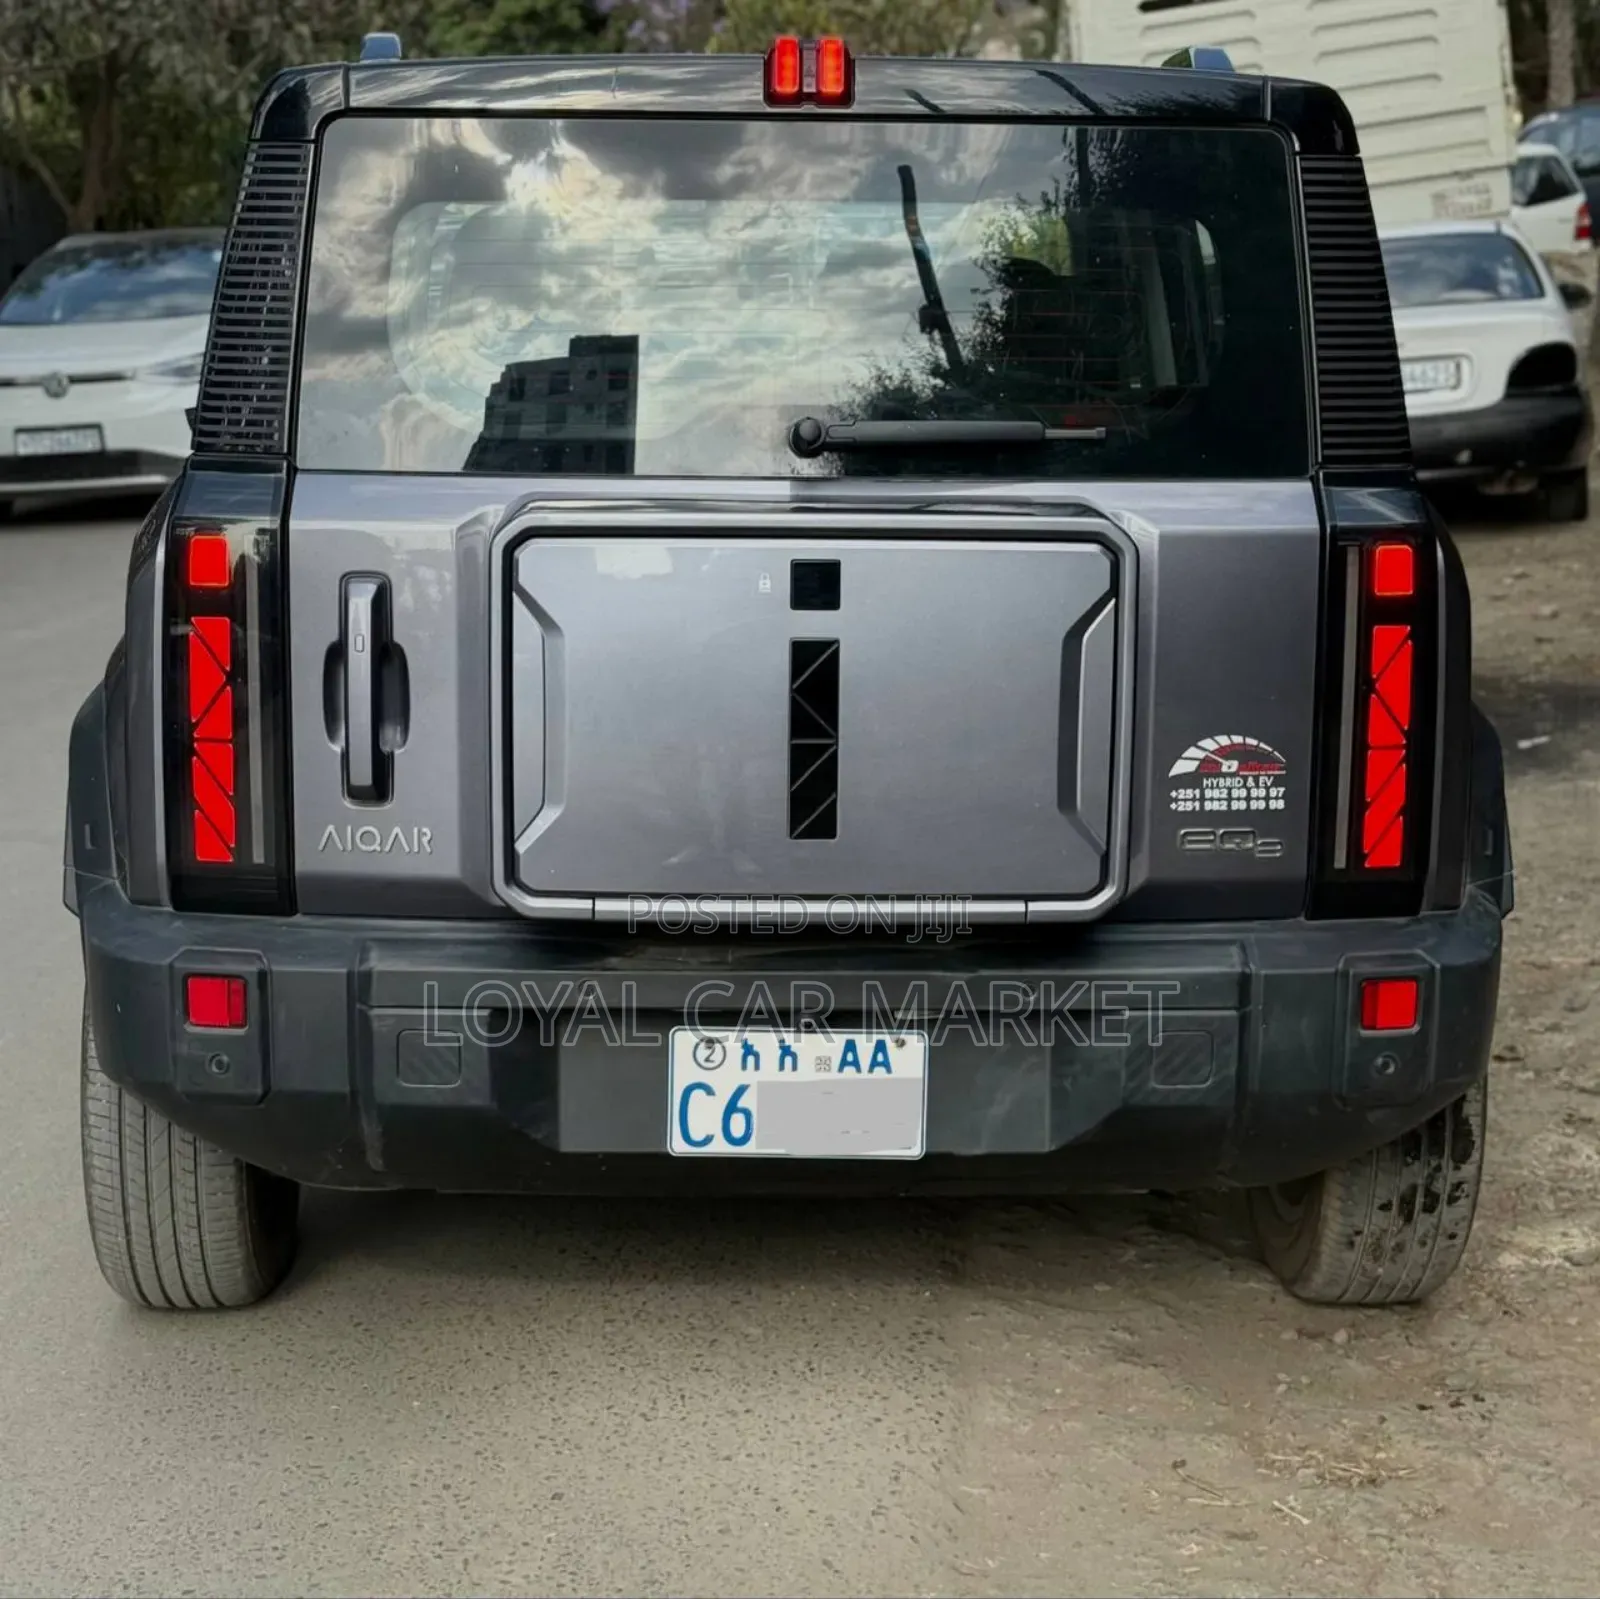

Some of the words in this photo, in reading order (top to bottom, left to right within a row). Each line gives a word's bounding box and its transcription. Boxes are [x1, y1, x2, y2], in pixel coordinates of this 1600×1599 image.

[1203, 777, 1244, 788] HYBRID
[1246, 777, 1256, 788] &
[1259, 776, 1275, 787] EV
[1170, 788, 1200, 799] +251
[1170, 800, 1200, 811] +251
[318, 824, 432, 854] AIQAR
[837, 1038, 893, 1075] AA
